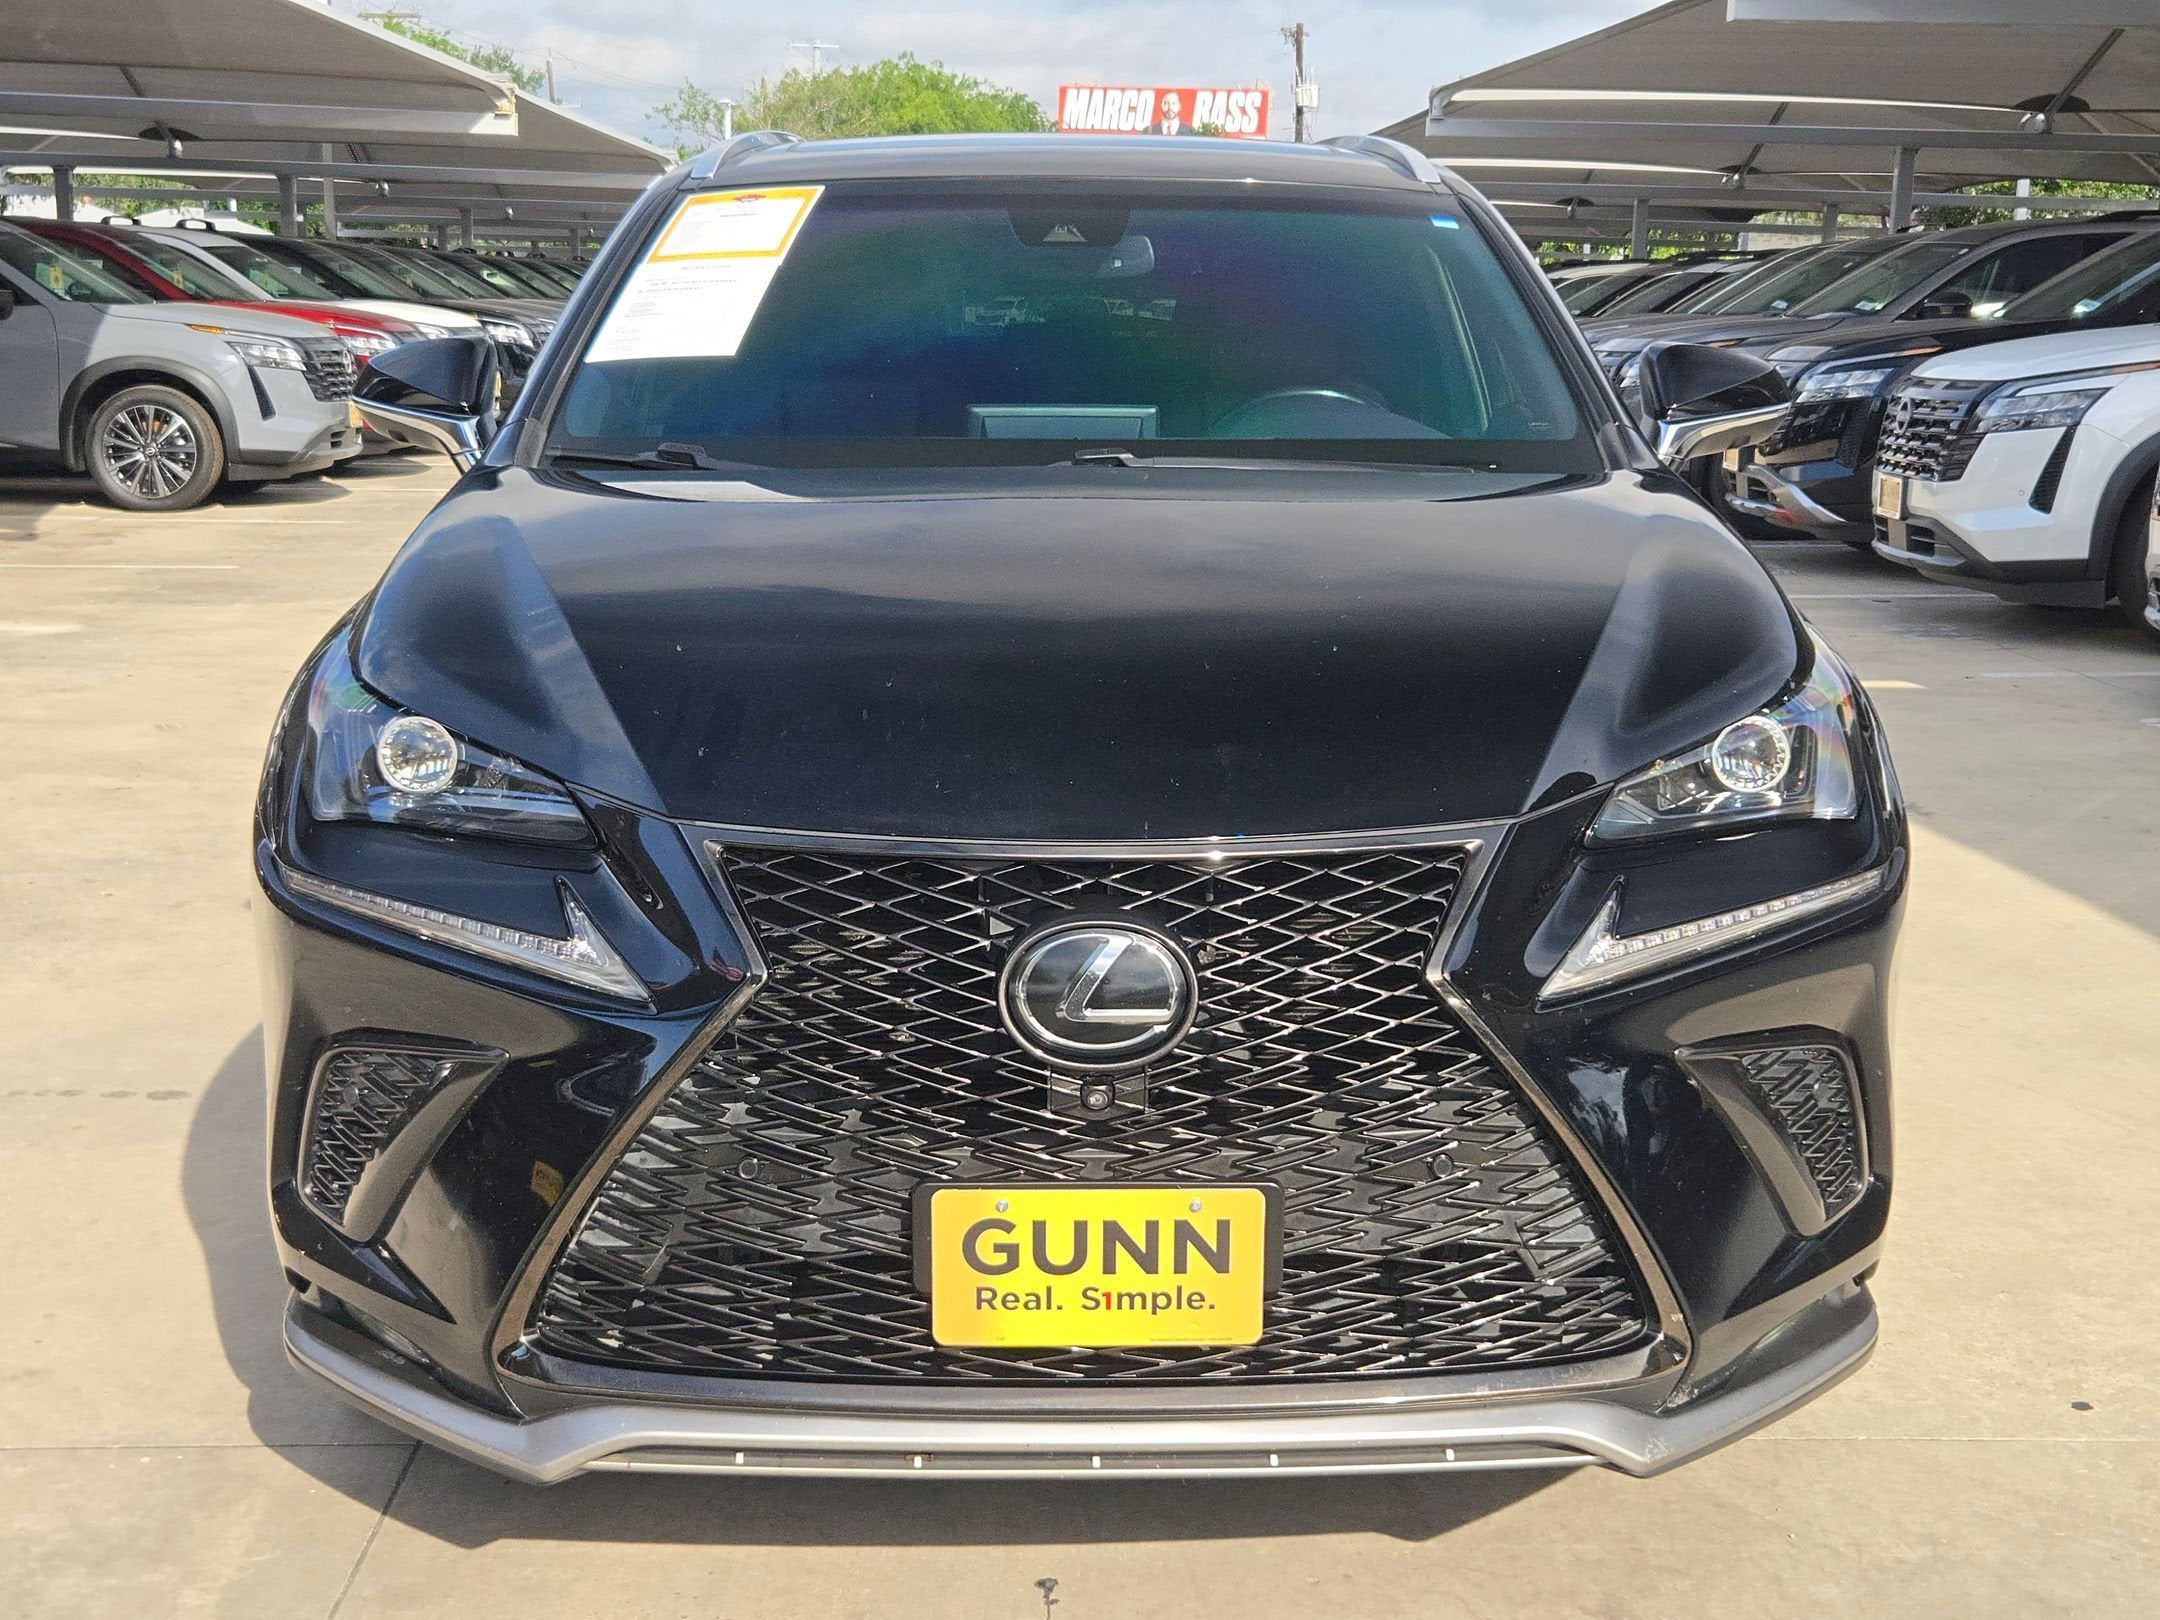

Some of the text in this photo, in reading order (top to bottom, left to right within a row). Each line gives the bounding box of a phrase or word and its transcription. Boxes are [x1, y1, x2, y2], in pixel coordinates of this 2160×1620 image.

[1062, 88, 1155, 131] MARCO
[962, 1217, 1231, 1276] GUNN
[976, 1285, 1064, 1311] Real.
